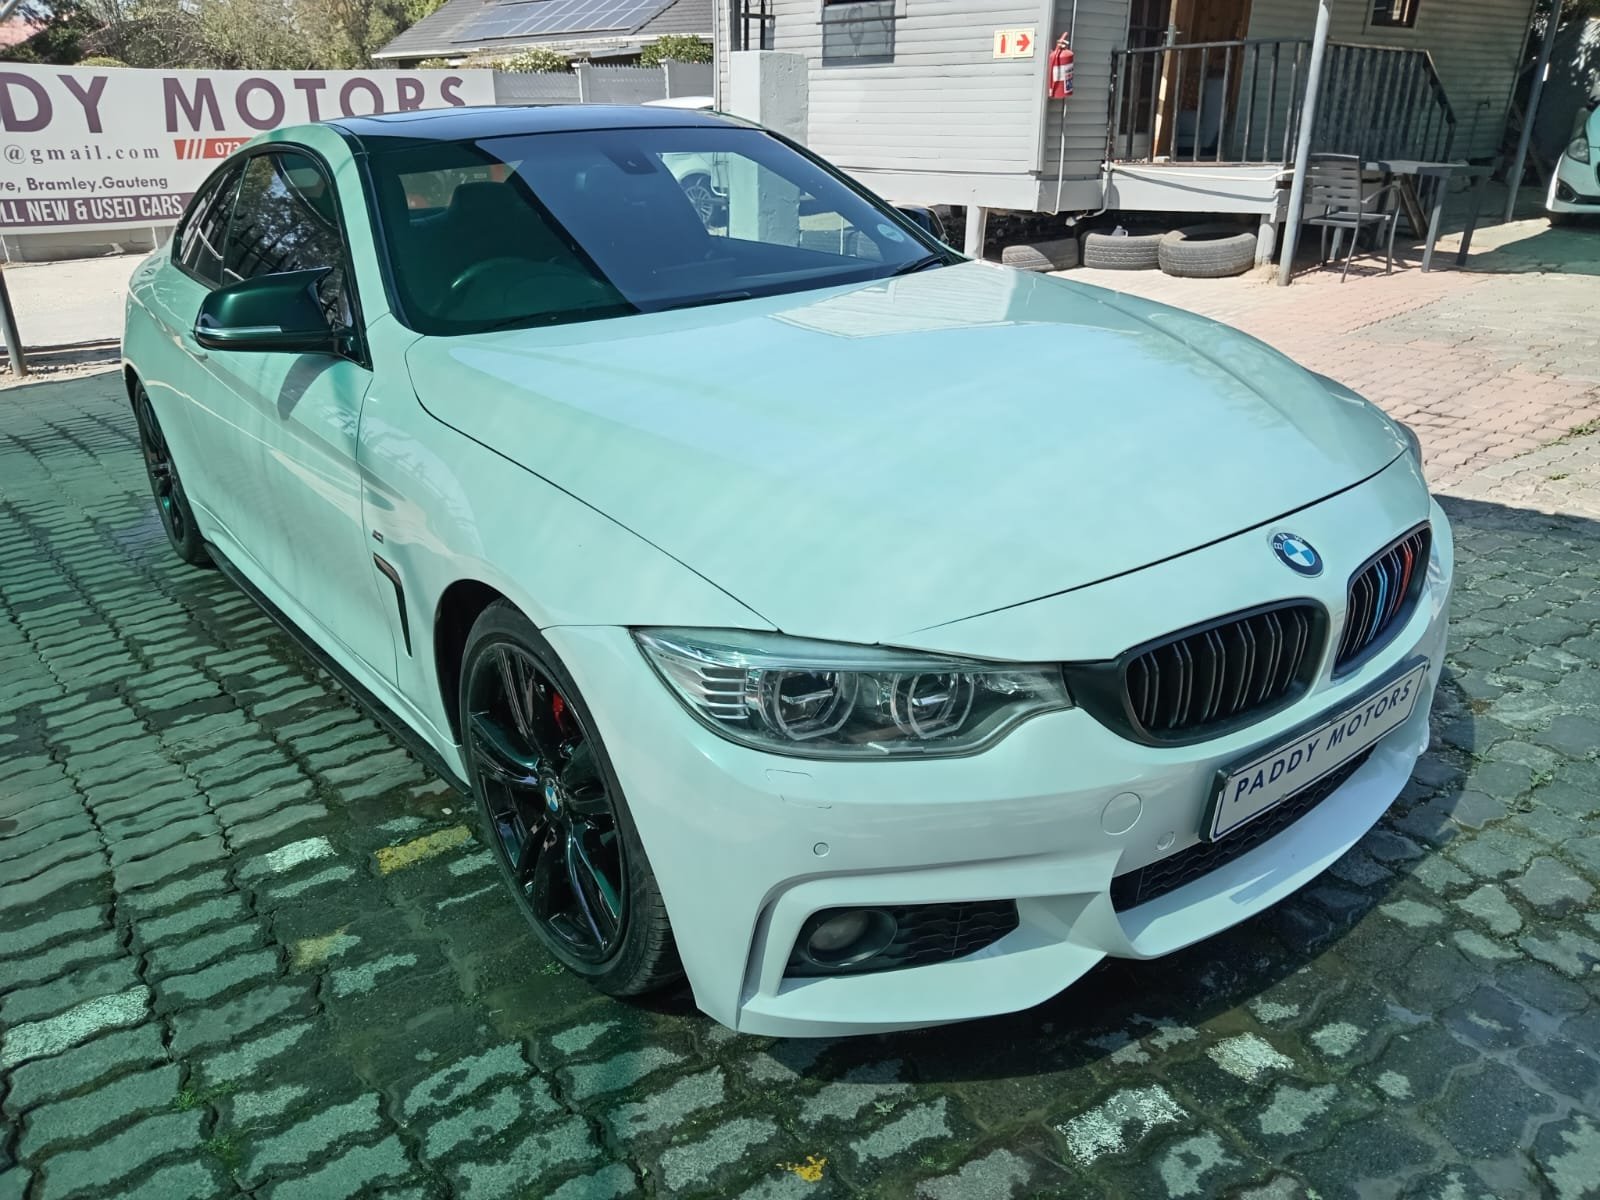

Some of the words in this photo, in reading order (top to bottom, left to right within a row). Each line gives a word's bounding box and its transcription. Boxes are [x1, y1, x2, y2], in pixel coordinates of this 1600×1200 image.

[163, 76, 466, 132] MOTORS
[4, 144, 160, 164] @gmail.com
[0, 200, 25, 223] LL
[26, 200, 70, 222] NEW
[74, 198, 88, 220] &
[90, 197, 137, 219] USED
[139, 195, 184, 217] CARS
[1234, 738, 1320, 802] PADDY
[1326, 680, 1413, 751] MOTORS
